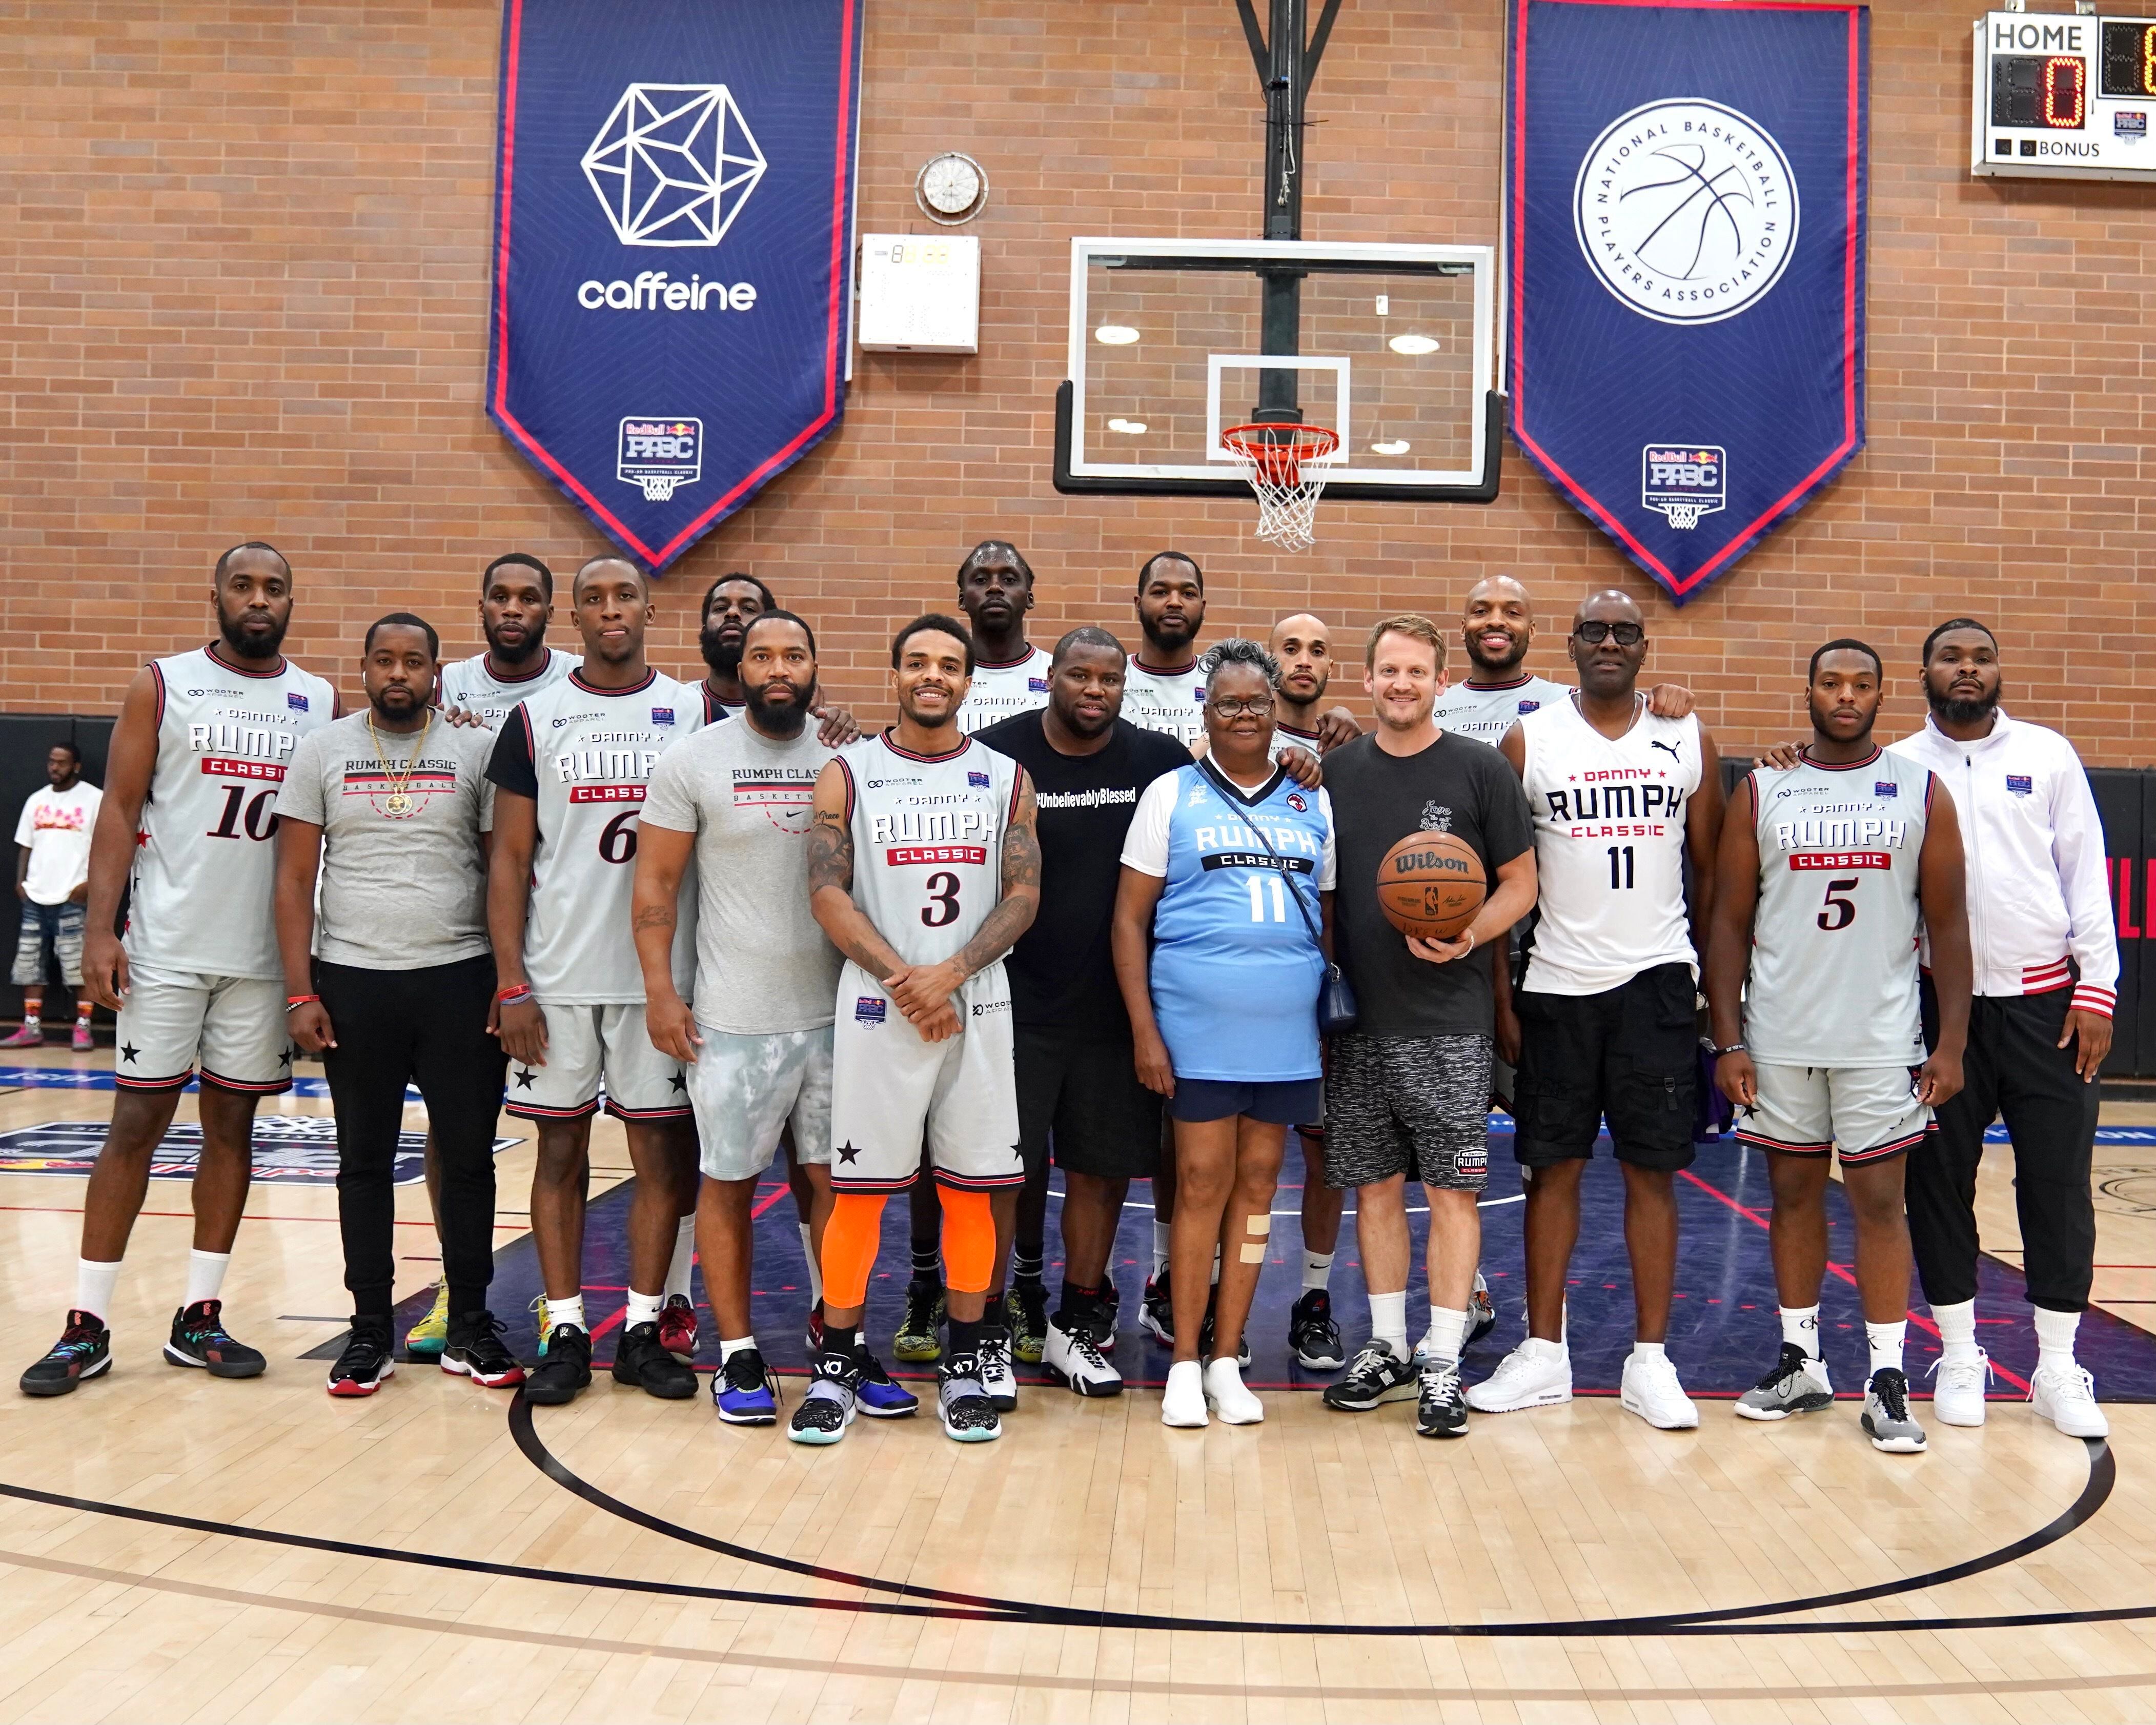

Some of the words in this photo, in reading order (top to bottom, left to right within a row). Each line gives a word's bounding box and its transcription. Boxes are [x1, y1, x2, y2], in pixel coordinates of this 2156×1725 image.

[1996, 24, 2082, 50] HOME
[2046, 57, 2083, 127] 0
[2040, 141, 2100, 156] BONUS
[1597, 124, 1668, 204] NATIONAL
[1683, 121, 1777, 208] BASKETBALL
[1598, 216, 1653, 291] PLAYERS
[1663, 221, 1776, 301] ASSOCIATION
[578, 271, 757, 311] caffeine
[626, 436, 694, 458] PABC
[1650, 463, 1718, 487] PABC
[971, 697, 1026, 706] DANNY
[1140, 707, 1193, 716] DANNY
[226, 707, 287, 724] DANNY
[188, 722, 303, 760] RUMP
[589, 732, 650, 743] DANNY
[210, 761, 287, 779] CLASSI
[555, 750, 661, 783] RUMP
[732, 768, 783, 779] RUMPH
[787, 769, 820, 779] CLAS
[1583, 768, 1651, 782] DANNY
[578, 788, 644, 799] CLASS
[907, 794, 968, 805] DANNY
[1036, 786, 1136, 808] #UnbelievablyBlessed
[1545, 785, 1684, 822] RUMPH
[207, 785, 279, 841] 10
[1811, 803, 1872, 814] DANNY
[599, 810, 640, 864] 6
[871, 810, 998, 843] RUMPH
[1571, 825, 1664, 838] CLASSIC
[1775, 818, 1906, 850] RUMPH
[1194, 825, 1317, 856] RUMPH
[896, 848, 980, 861] CLASSIC
[1395, 851, 1469, 875] Wilson
[1798, 855, 1883, 866] CLASSIC
[1607, 846, 1634, 889] 11
[921, 871, 961, 927] 3
[1245, 876, 1286, 923] 11
[1817, 877, 1859, 931] 5
